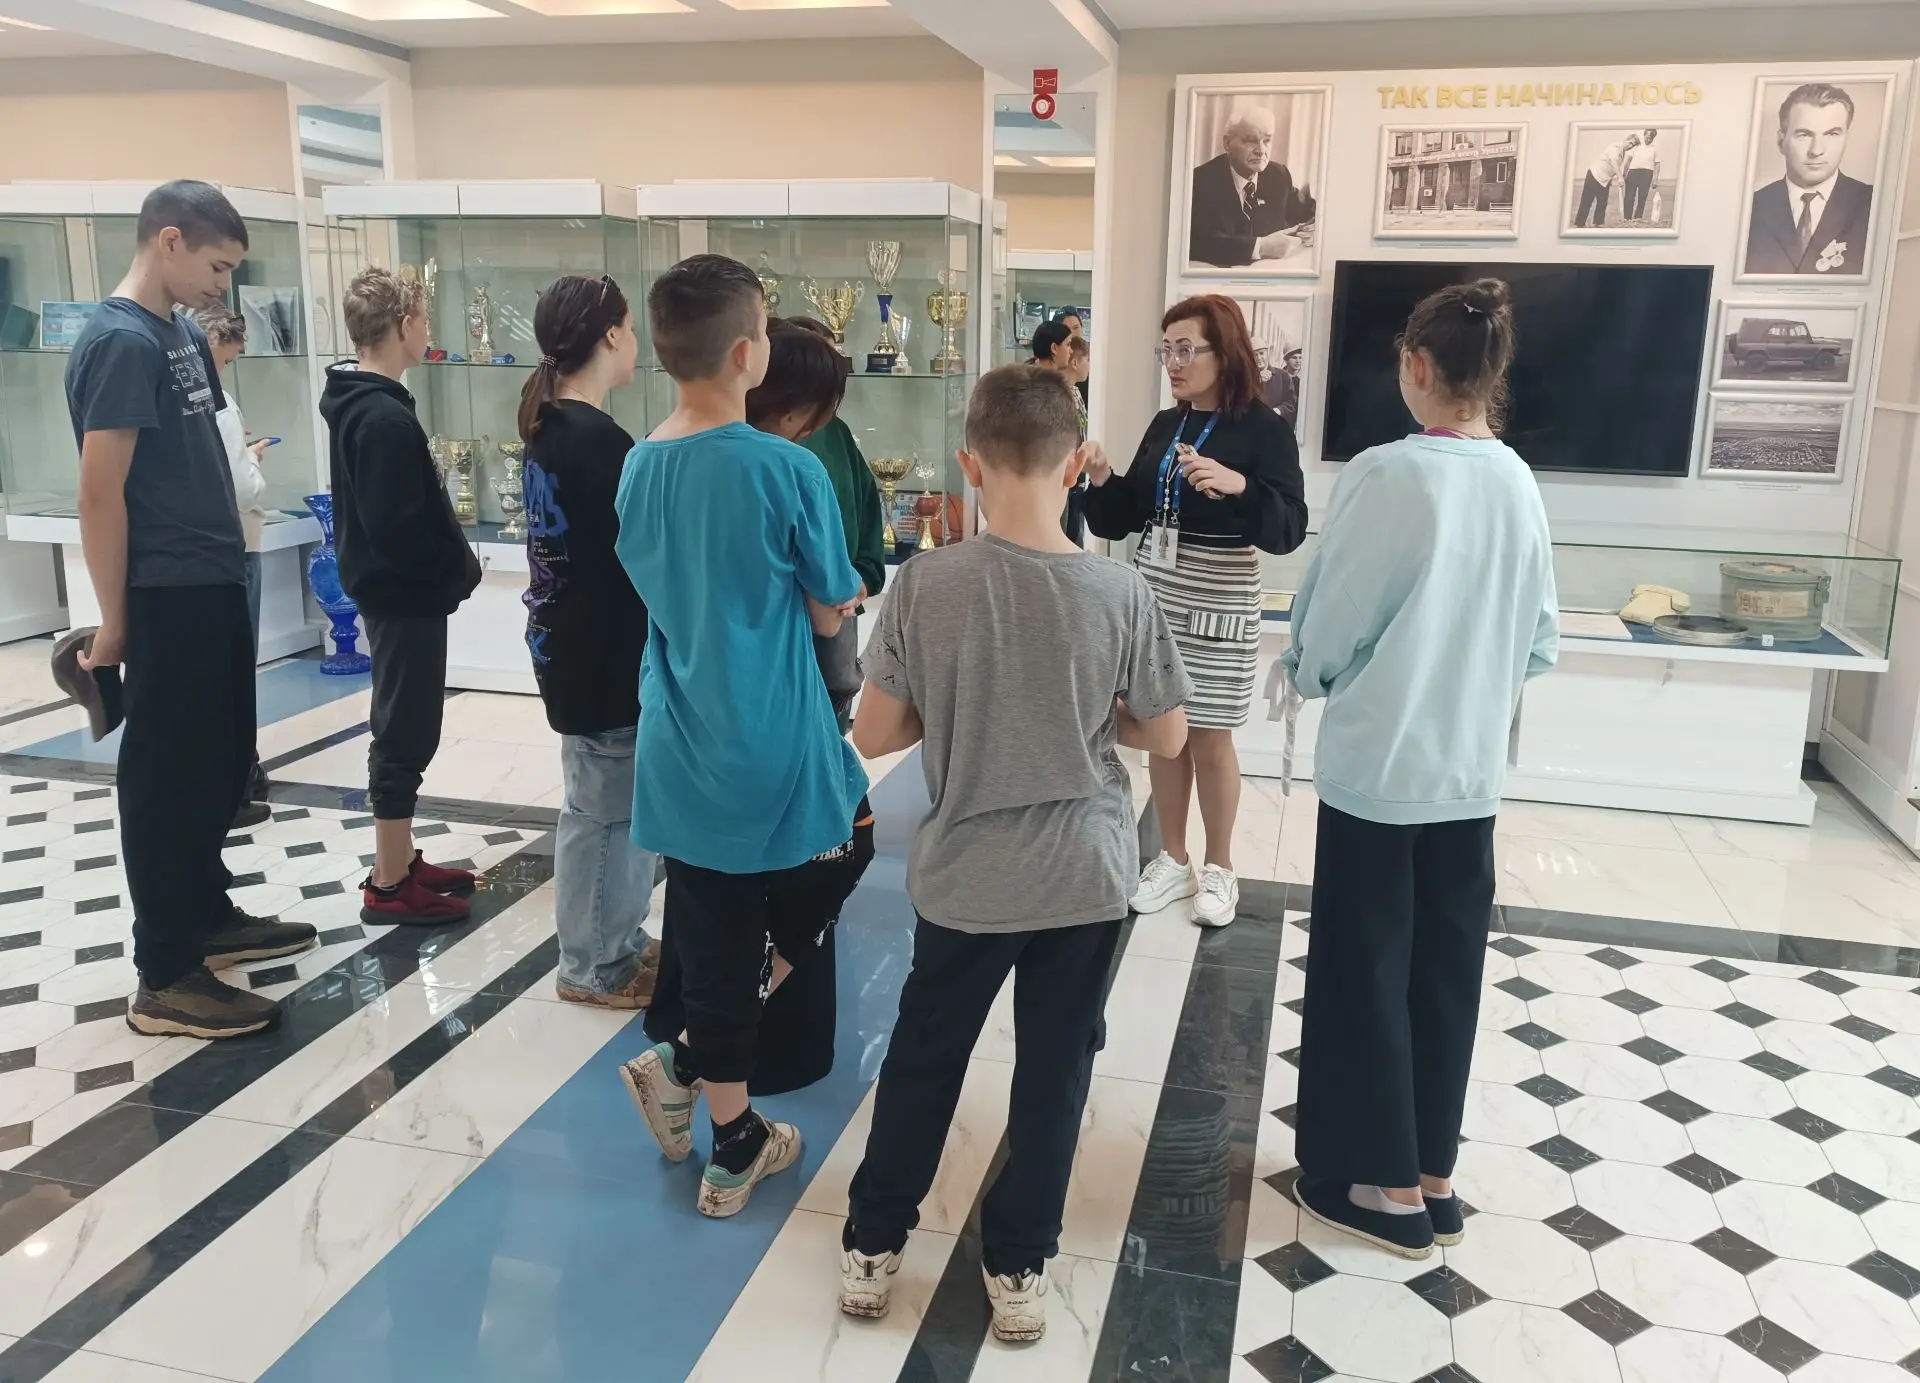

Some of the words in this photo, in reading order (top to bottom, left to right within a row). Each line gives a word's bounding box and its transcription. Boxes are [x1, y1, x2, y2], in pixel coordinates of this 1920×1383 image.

[1377, 85, 1429, 109] ТАК
[1436, 84, 1488, 109] ВСЕ
[1495, 80, 1704, 108] НАЧИНАЛОСЬ
